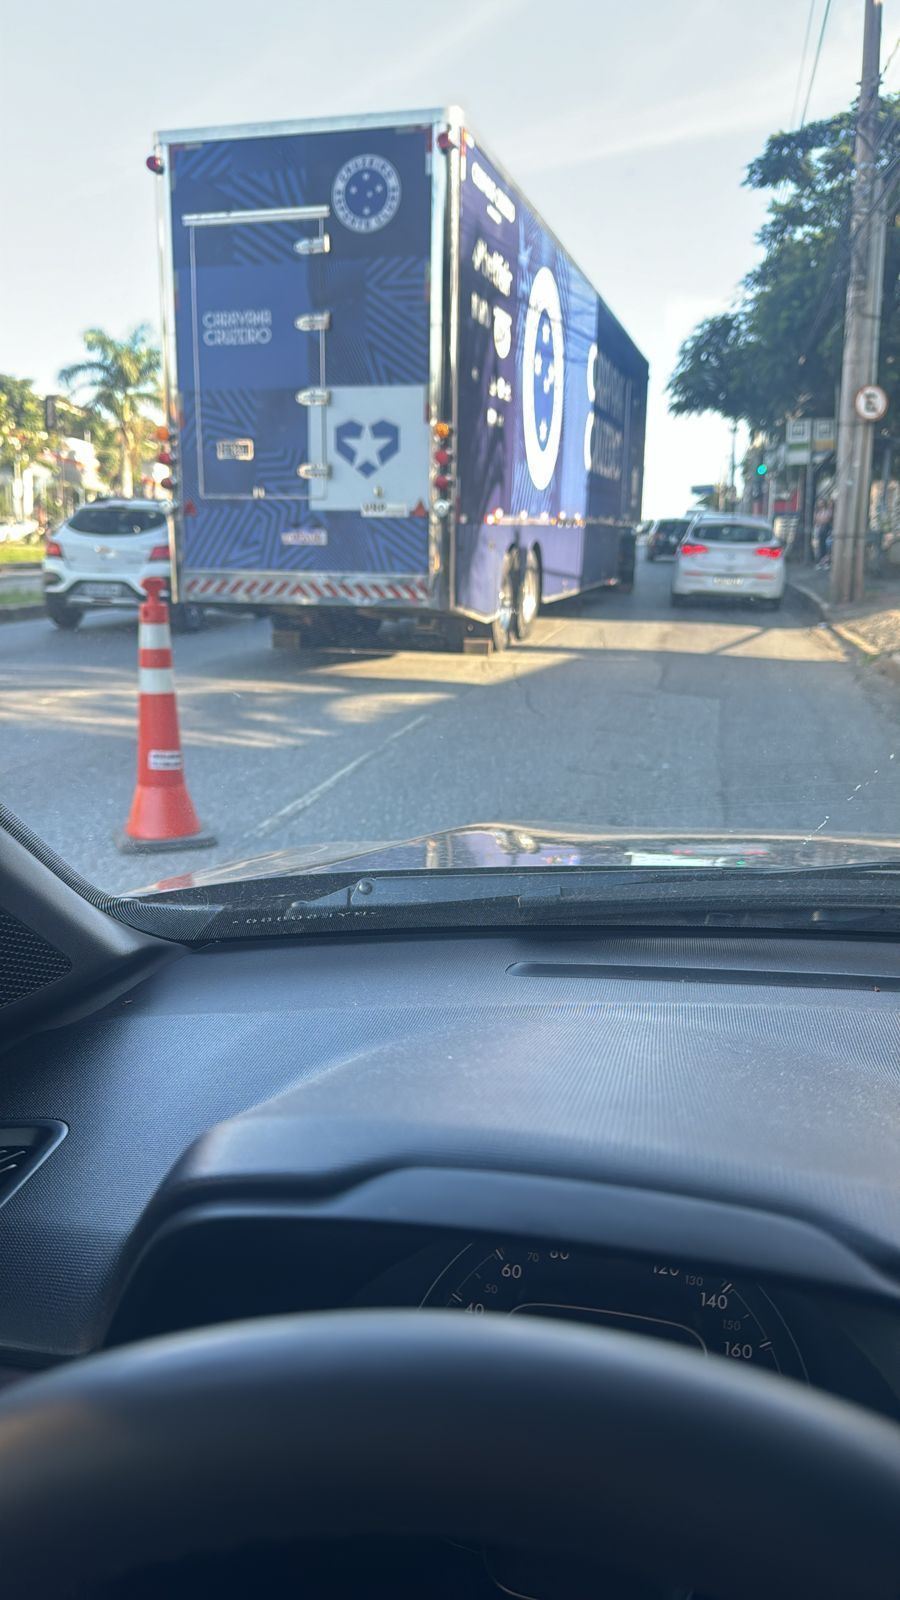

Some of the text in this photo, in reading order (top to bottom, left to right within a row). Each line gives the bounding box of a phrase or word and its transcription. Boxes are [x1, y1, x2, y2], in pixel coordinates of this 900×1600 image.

[203, 328, 273, 346] CRUZEIRO
[527, 1251, 539, 1262] 70
[501, 1263, 523, 1279] 60
[686, 1274, 704, 1287] 130
[485, 1284, 498, 1294] 50
[700, 1292, 728, 1310] 140
[465, 1302, 485, 1314] 40
[722, 1319, 741, 1332] 150
[722, 1341, 753, 1359] 160
